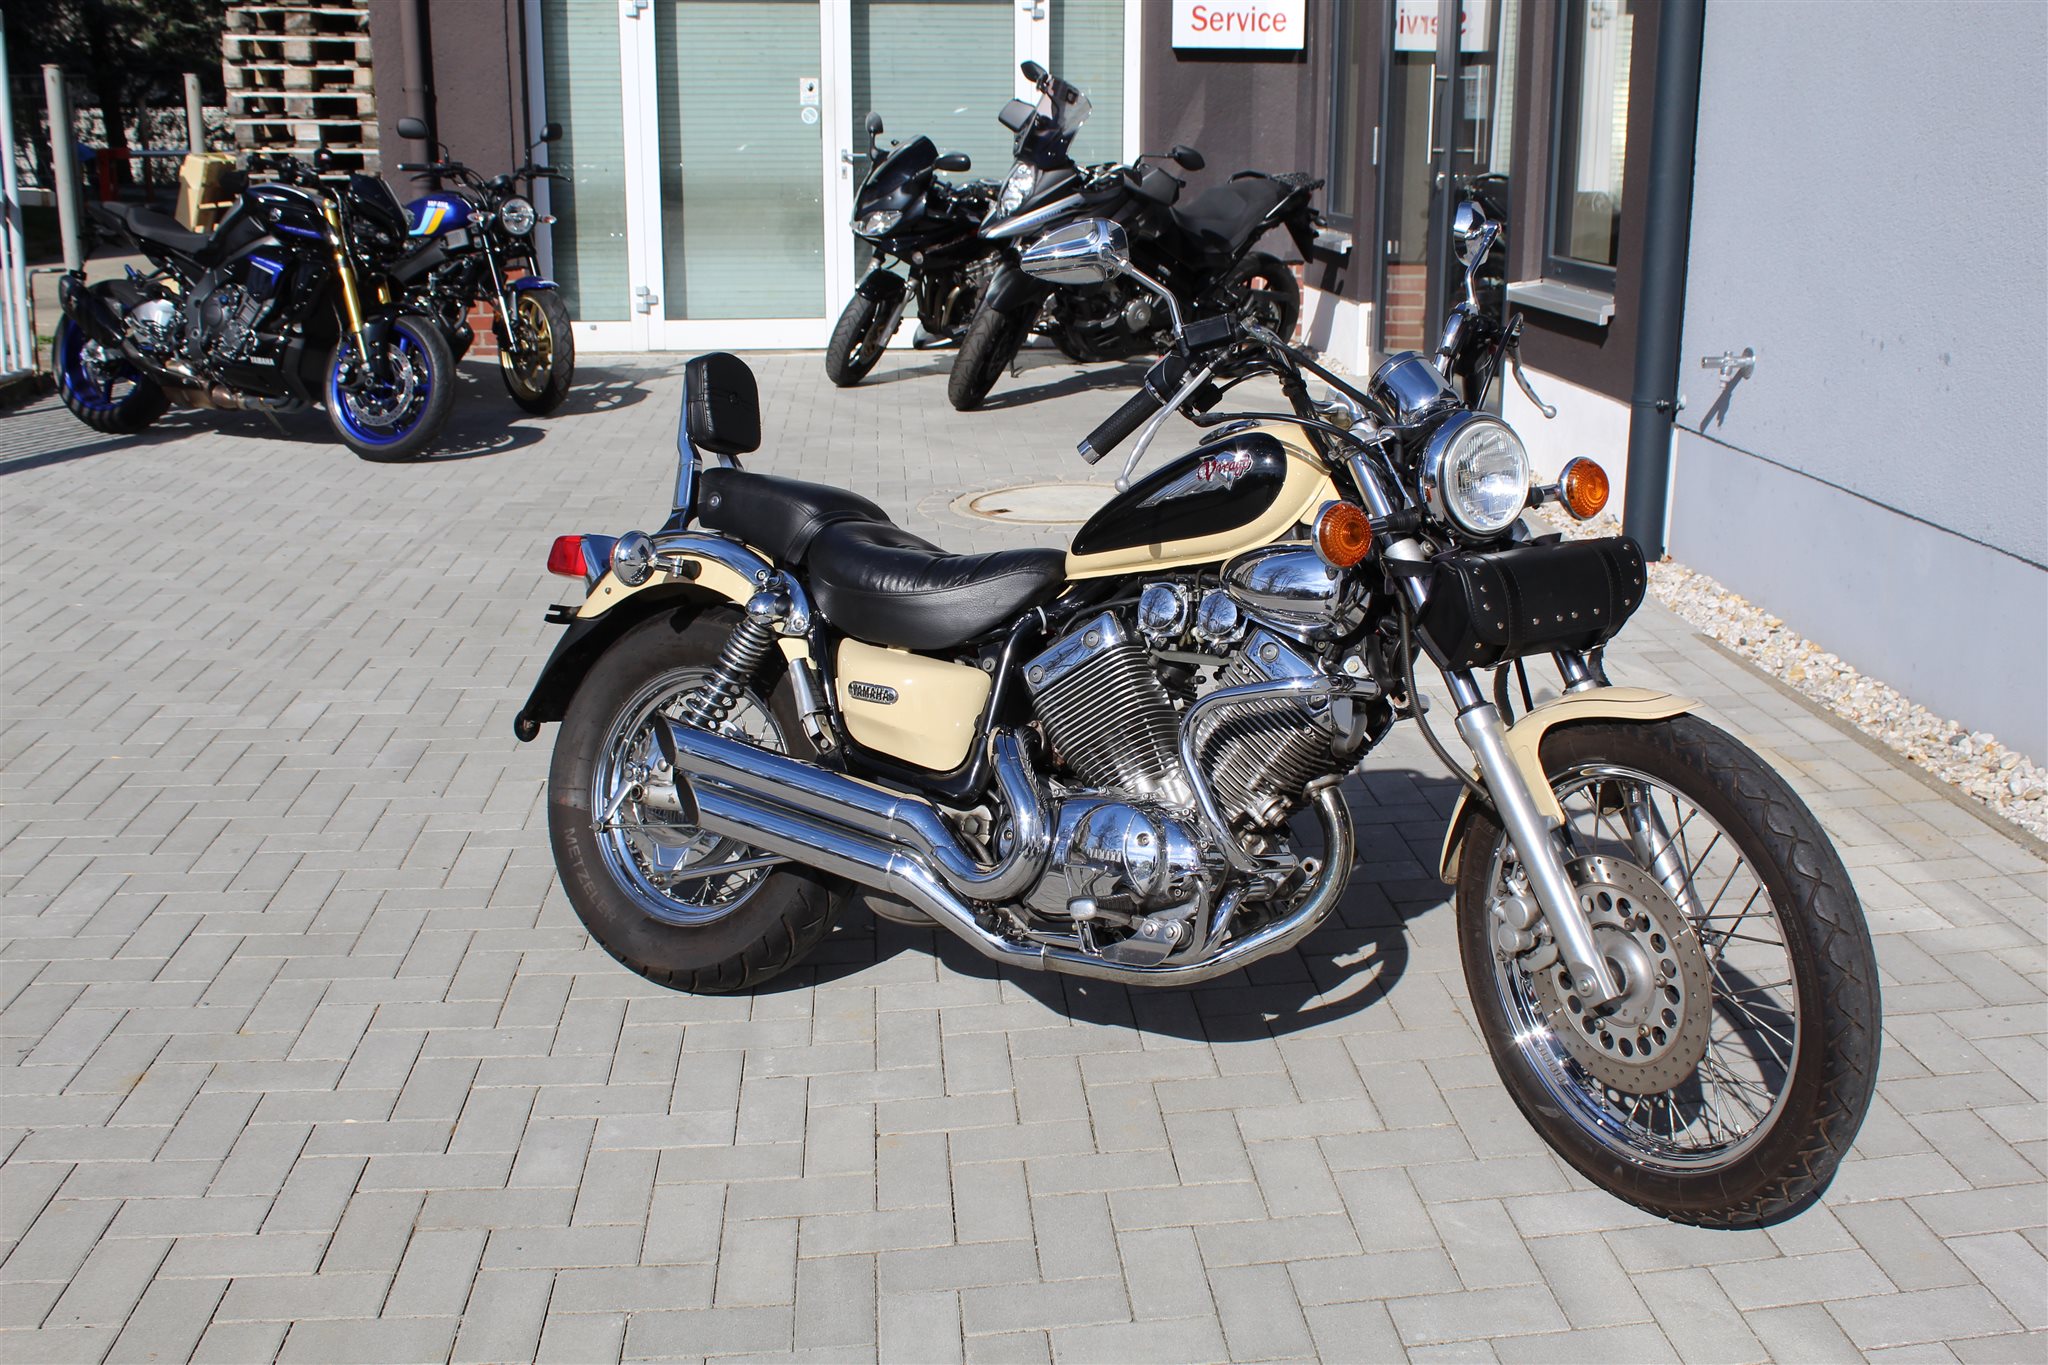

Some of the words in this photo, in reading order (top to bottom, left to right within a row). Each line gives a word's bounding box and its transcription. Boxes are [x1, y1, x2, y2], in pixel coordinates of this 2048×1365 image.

[1191, 5, 1287, 32] Service
[851, 683, 890, 702] YAMAHA
[564, 827, 617, 923] METZELER
